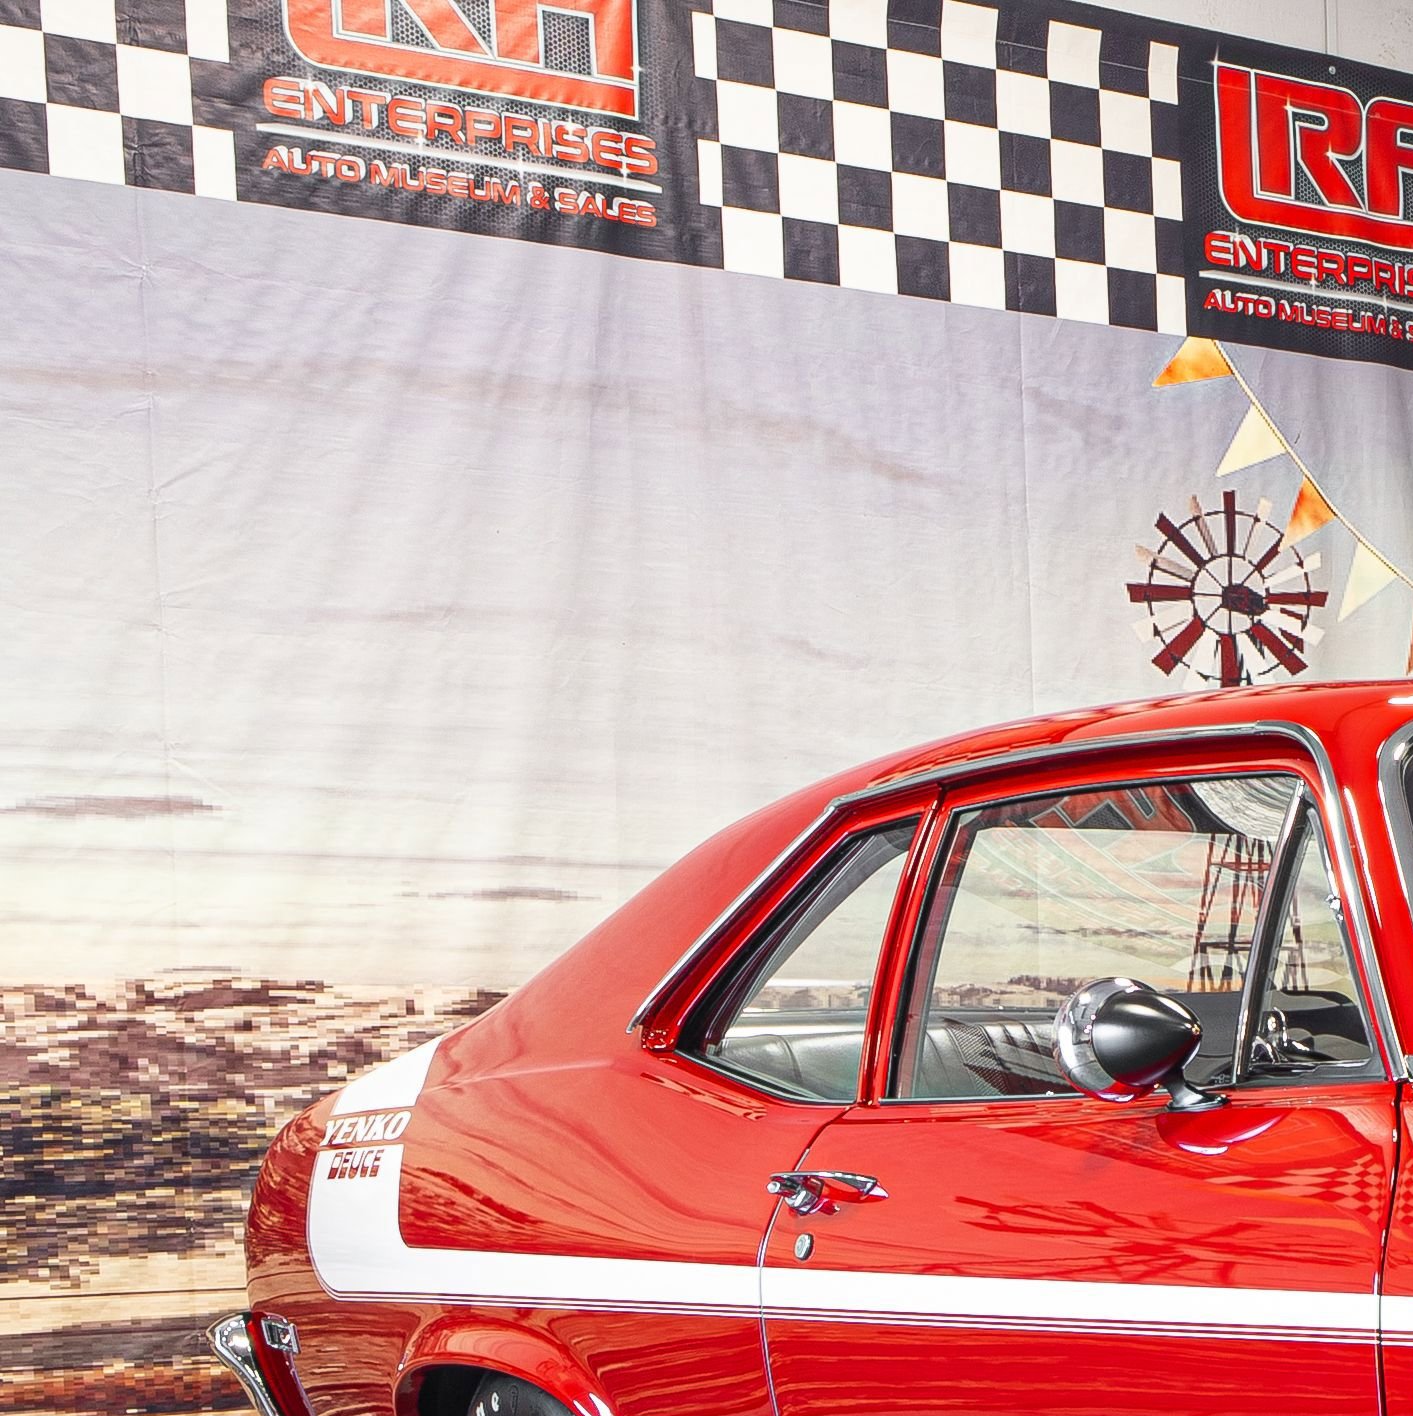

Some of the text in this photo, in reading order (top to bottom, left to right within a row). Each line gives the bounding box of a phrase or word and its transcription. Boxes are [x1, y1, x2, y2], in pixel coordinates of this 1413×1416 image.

[262, 76, 657, 175] ENTERPRISES
[262, 145, 657, 227] AUTO MUSEUM & SALES
[1204, 289, 1275, 319] AUTO
[1278, 300, 1386, 335] MUSEUM
[1389, 319, 1403, 339] &
[319, 1111, 412, 1147] YENKO
[327, 1149, 385, 1180] DEUCE
